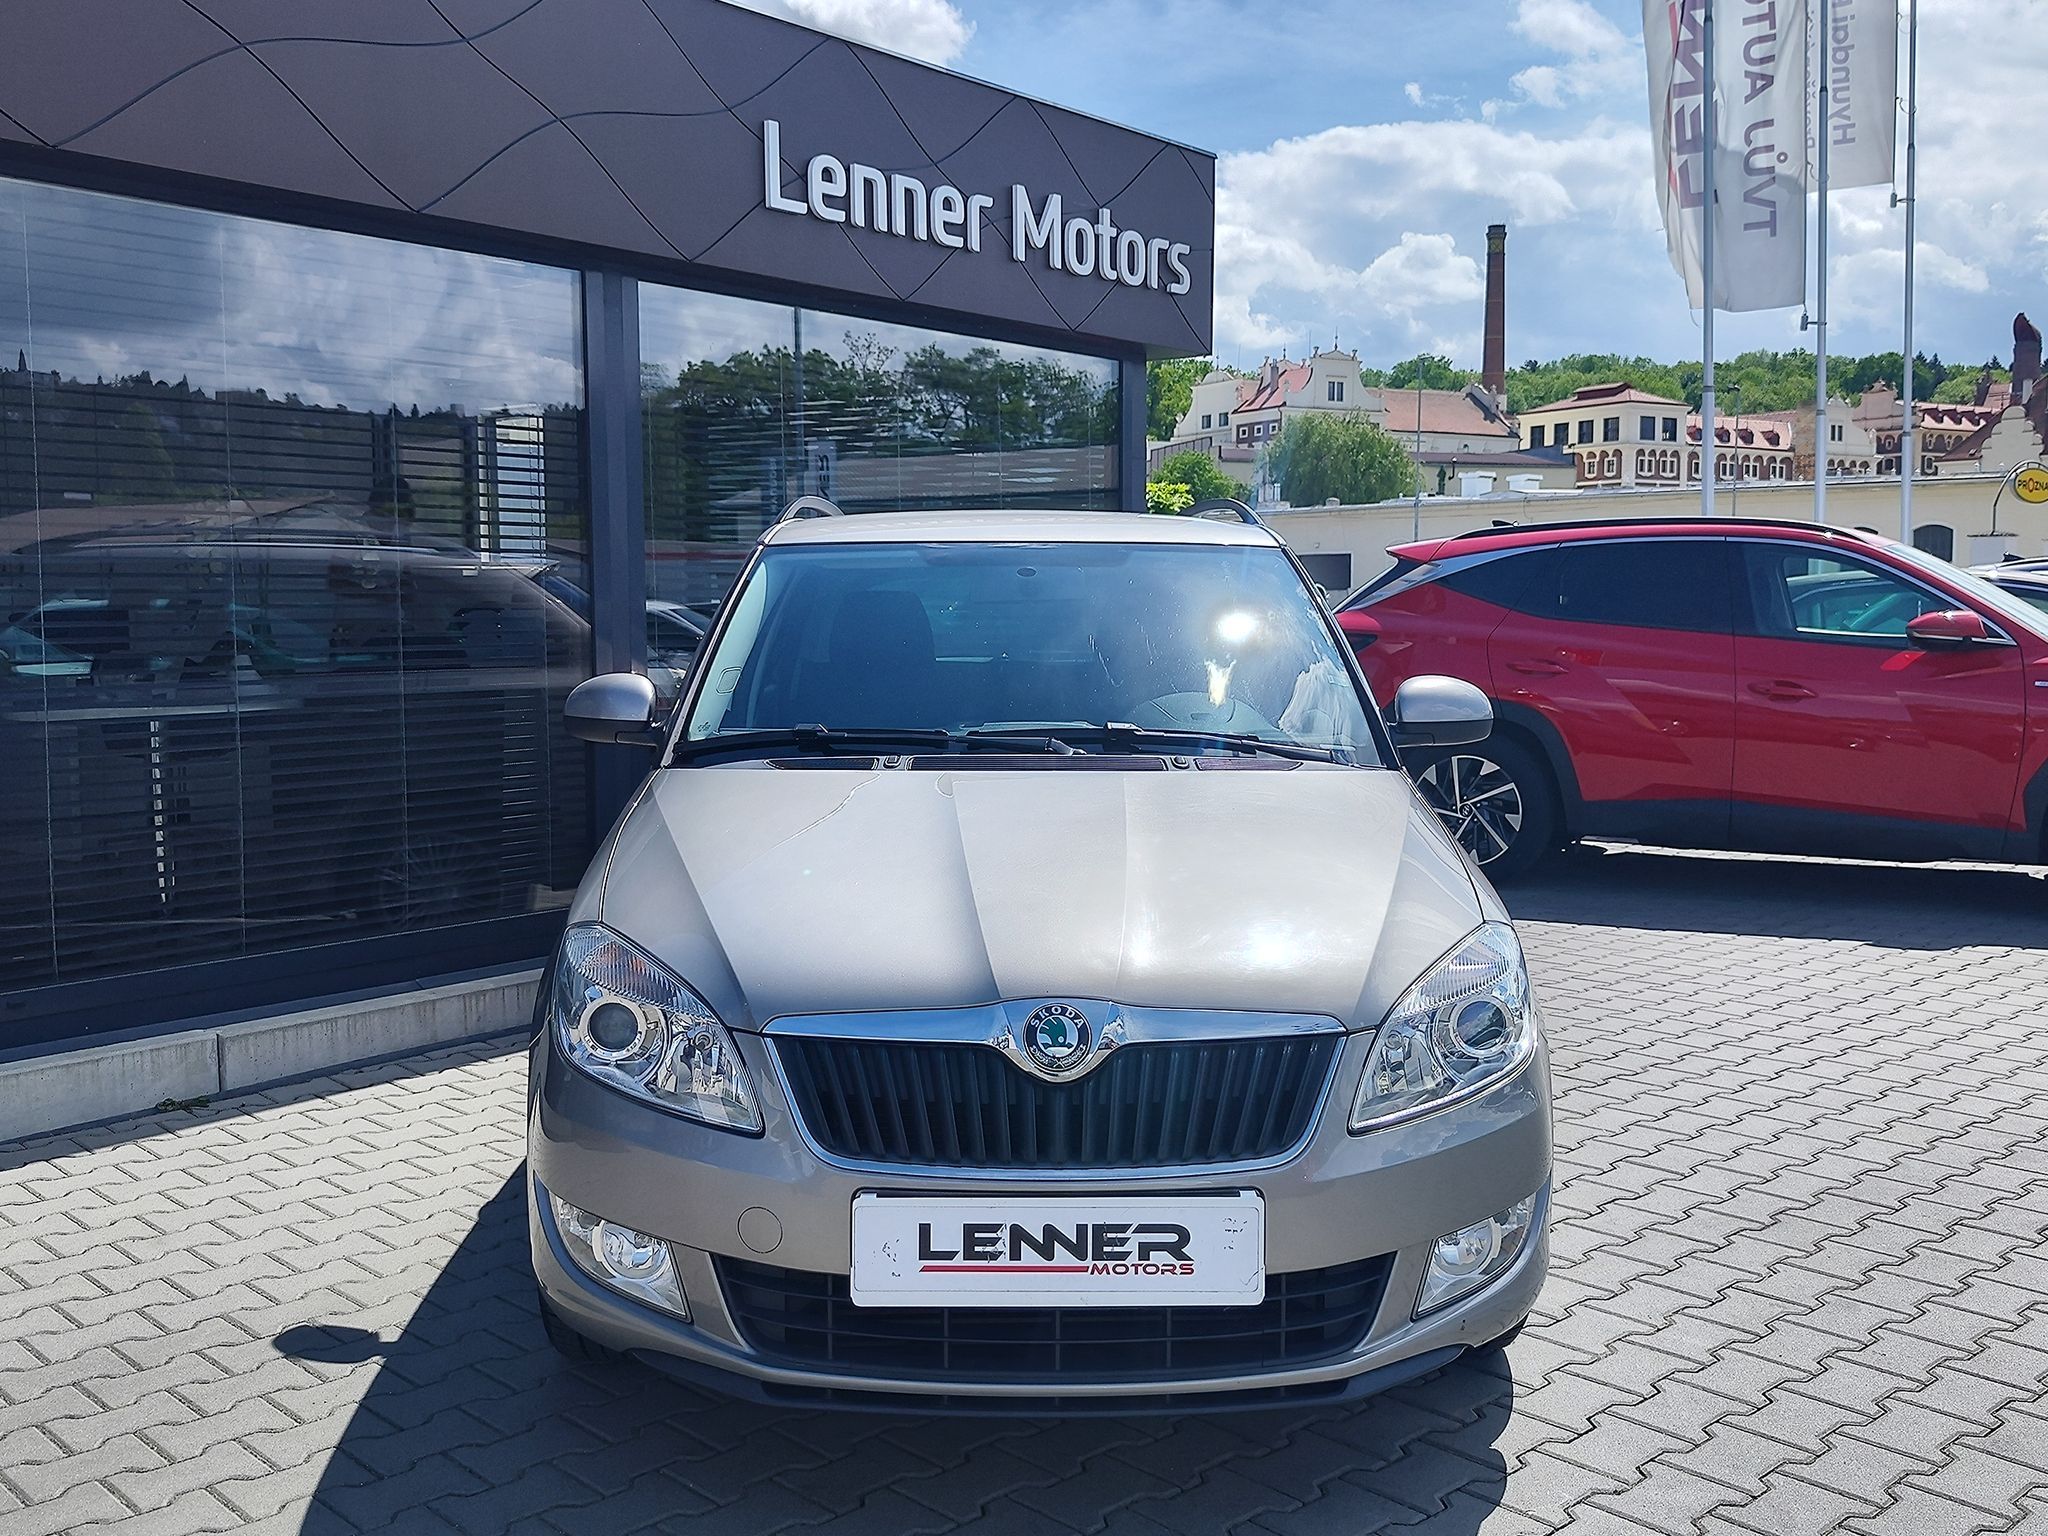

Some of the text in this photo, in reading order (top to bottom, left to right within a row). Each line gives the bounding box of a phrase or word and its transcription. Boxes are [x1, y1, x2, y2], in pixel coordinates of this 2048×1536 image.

[763, 119, 1191, 295] Lenner Motors
[918, 1222, 1194, 1261] LENNER
[1089, 1263, 1195, 1276] MOTORS
